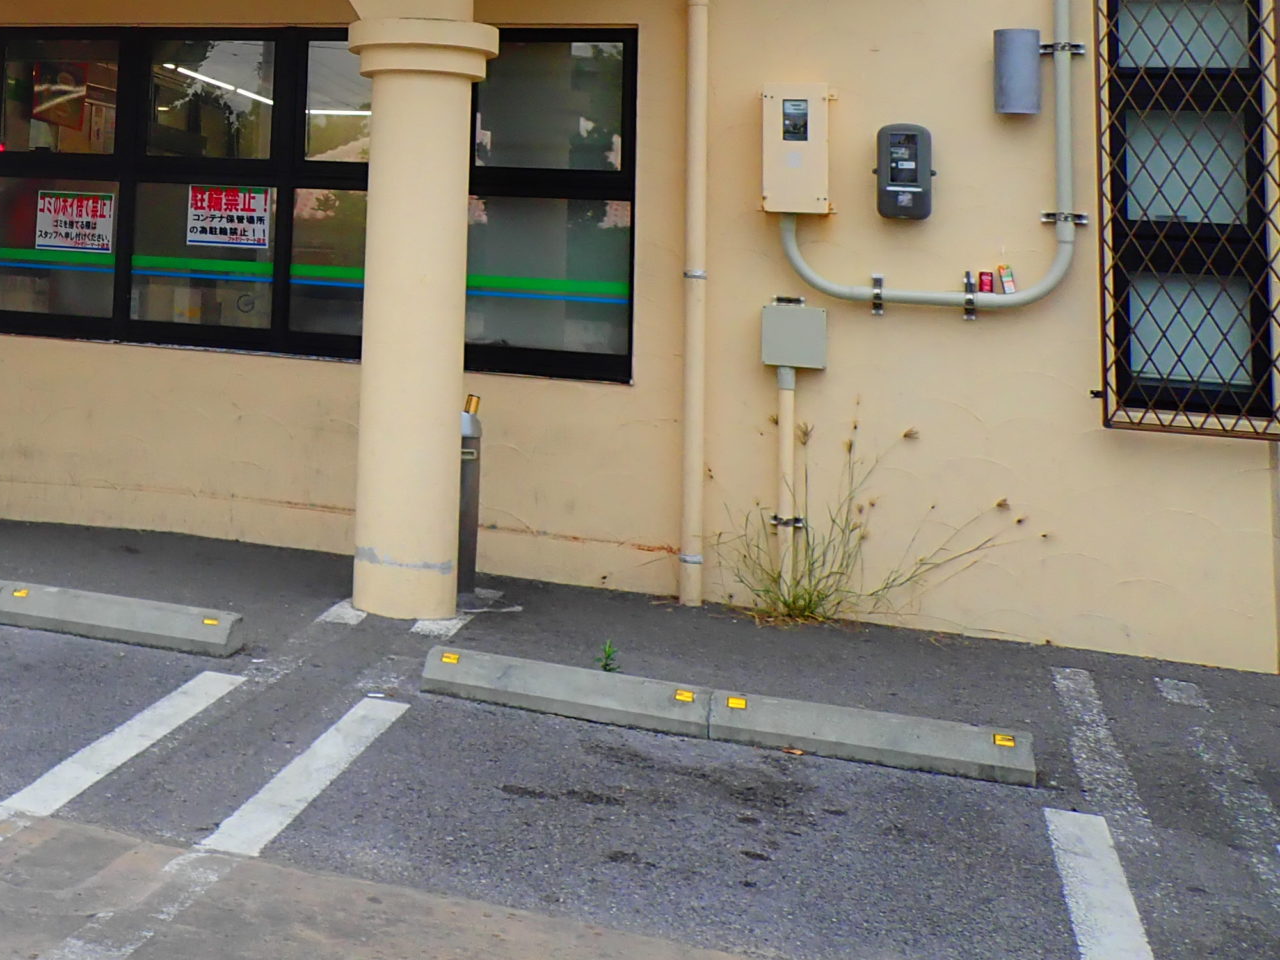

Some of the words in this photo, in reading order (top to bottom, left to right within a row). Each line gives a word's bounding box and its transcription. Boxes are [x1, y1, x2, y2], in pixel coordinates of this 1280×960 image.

[39, 195, 112, 218] ゴミのポイ捨て禁止！
[191, 186, 269, 213] 駐輪禁止！
[192, 214, 265, 225] コンテナ保管場所
